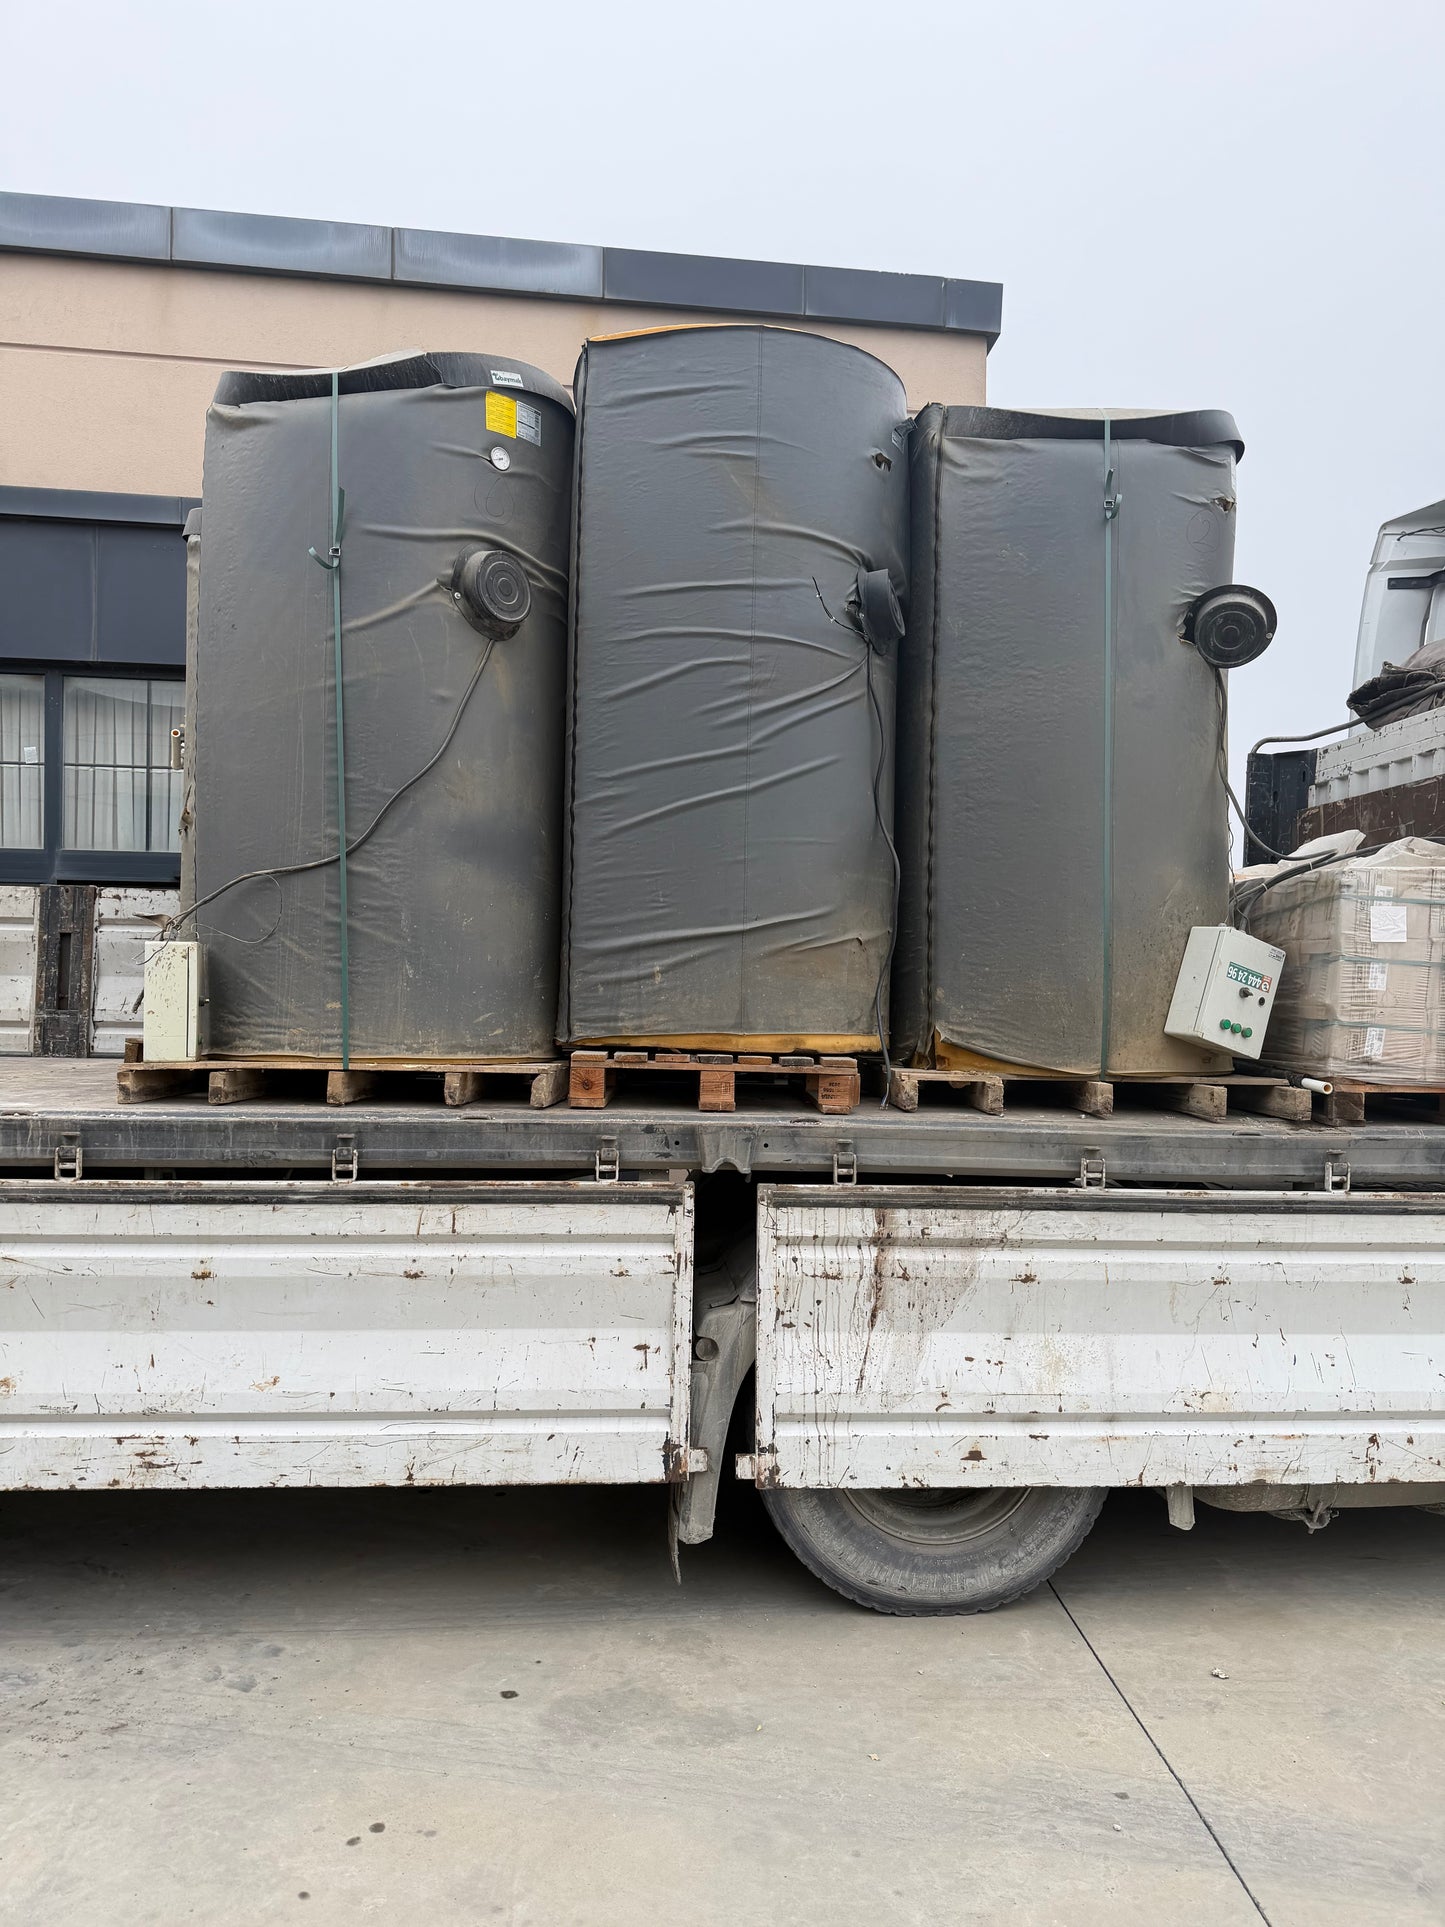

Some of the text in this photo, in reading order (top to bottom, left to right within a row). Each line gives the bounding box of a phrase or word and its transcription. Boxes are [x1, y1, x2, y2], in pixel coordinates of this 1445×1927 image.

[1227, 966, 1238, 979] 96
[1237, 970, 1248, 983] 24
[1247, 973, 1262, 989] 444
